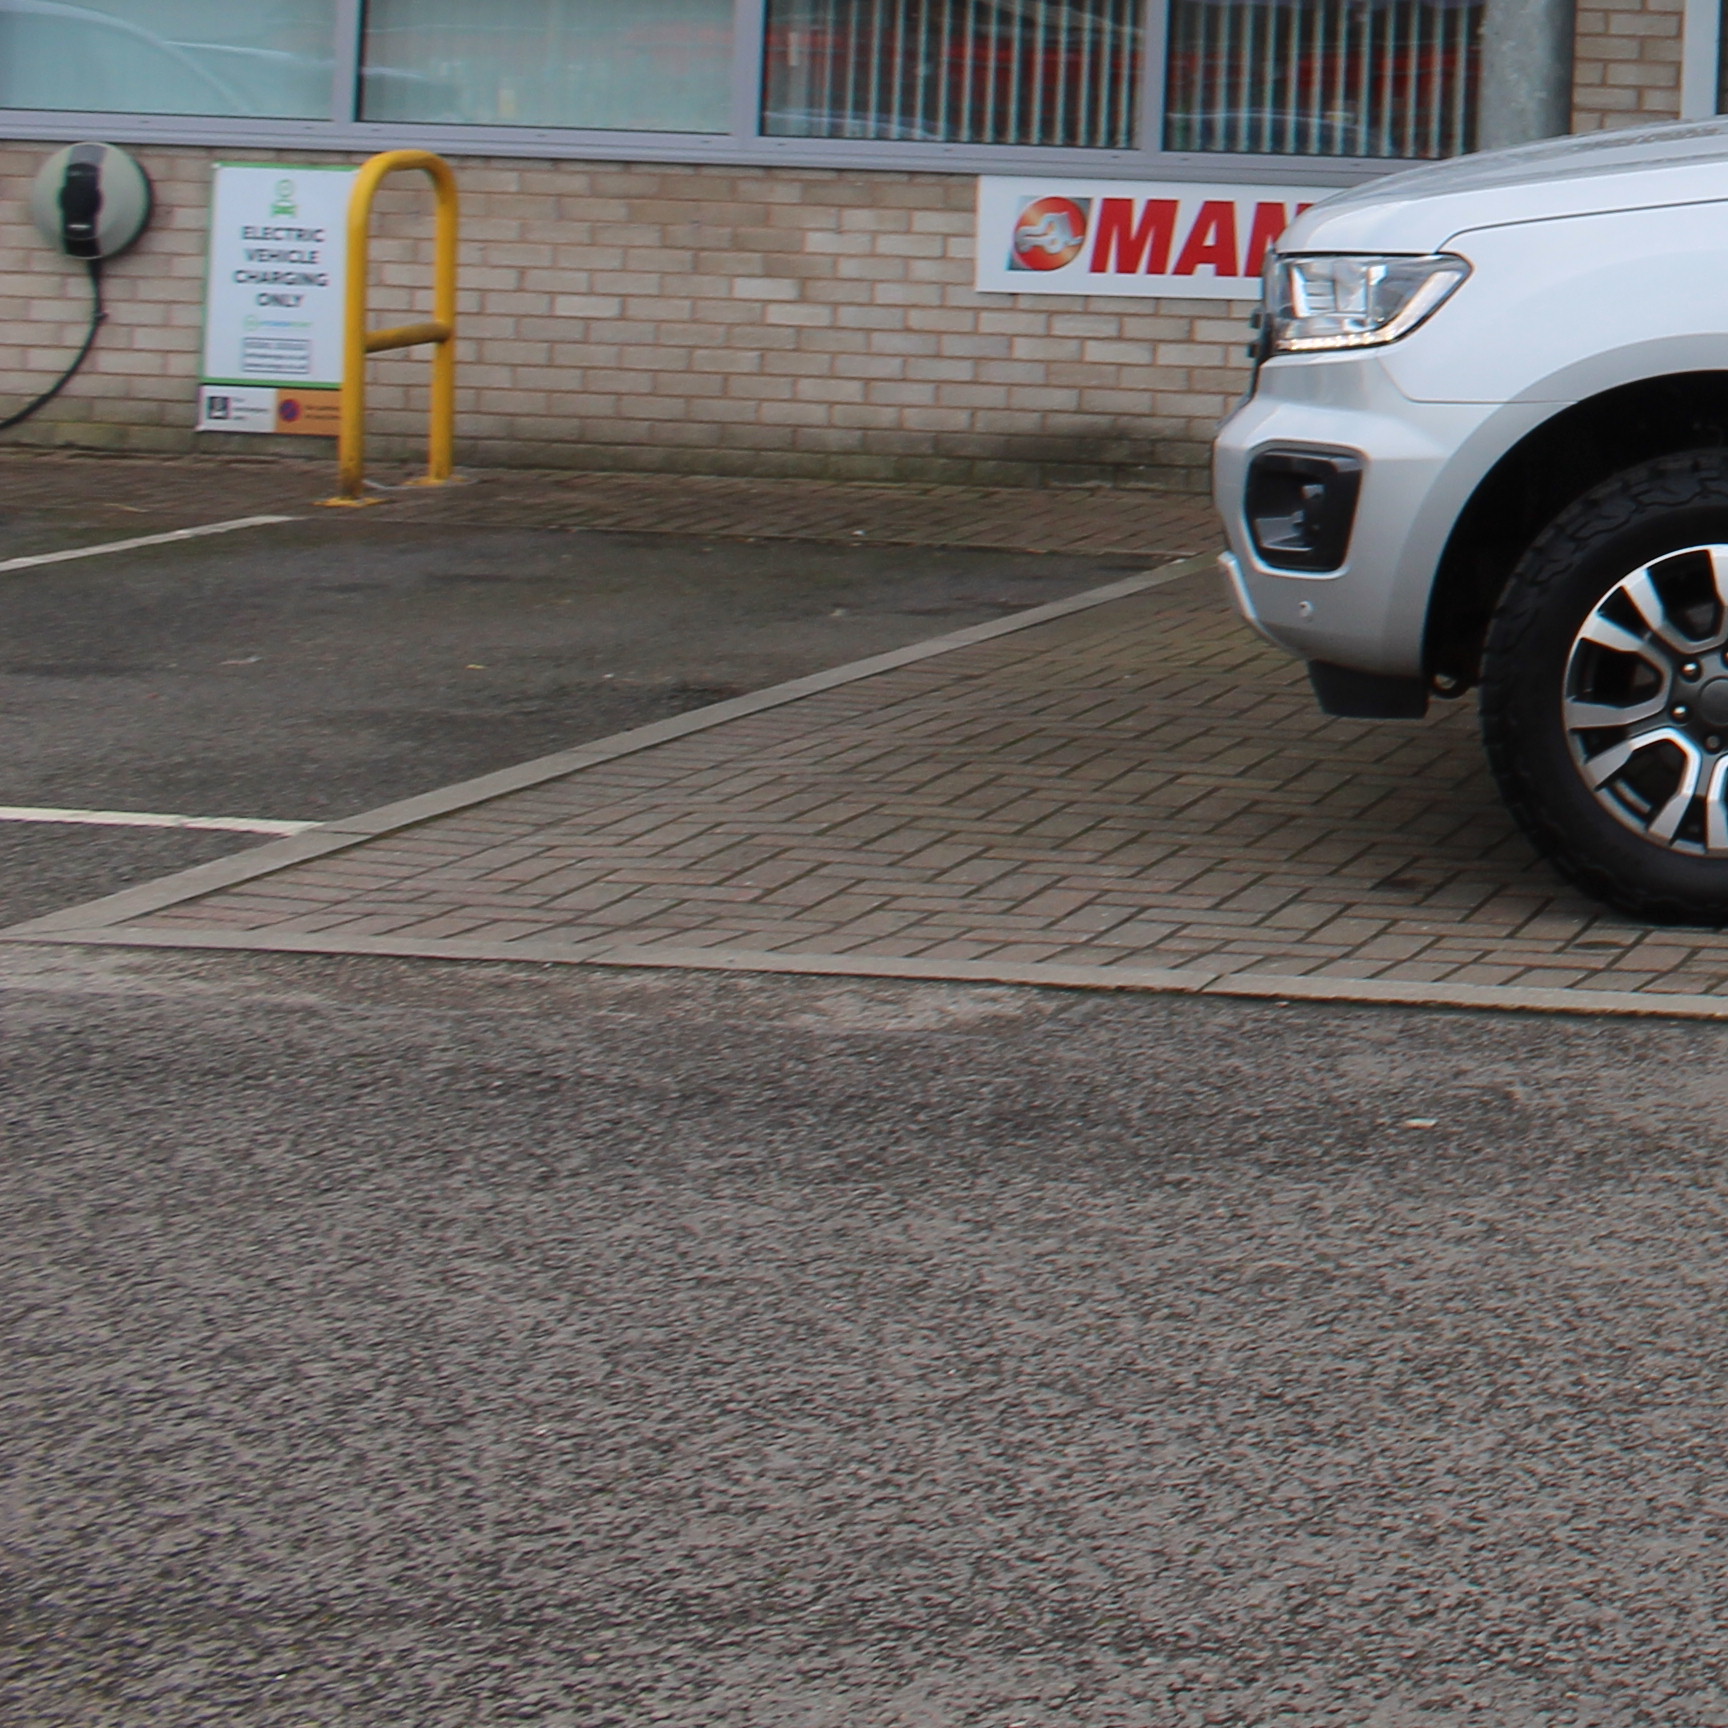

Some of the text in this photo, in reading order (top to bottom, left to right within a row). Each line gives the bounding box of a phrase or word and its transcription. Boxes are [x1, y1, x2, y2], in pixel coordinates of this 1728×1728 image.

[241, 225, 325, 243] ELECTRIC
[244, 248, 319, 264] VEHICLE
[234, 269, 329, 287] CHARGING
[256, 292, 304, 307] ONLY
